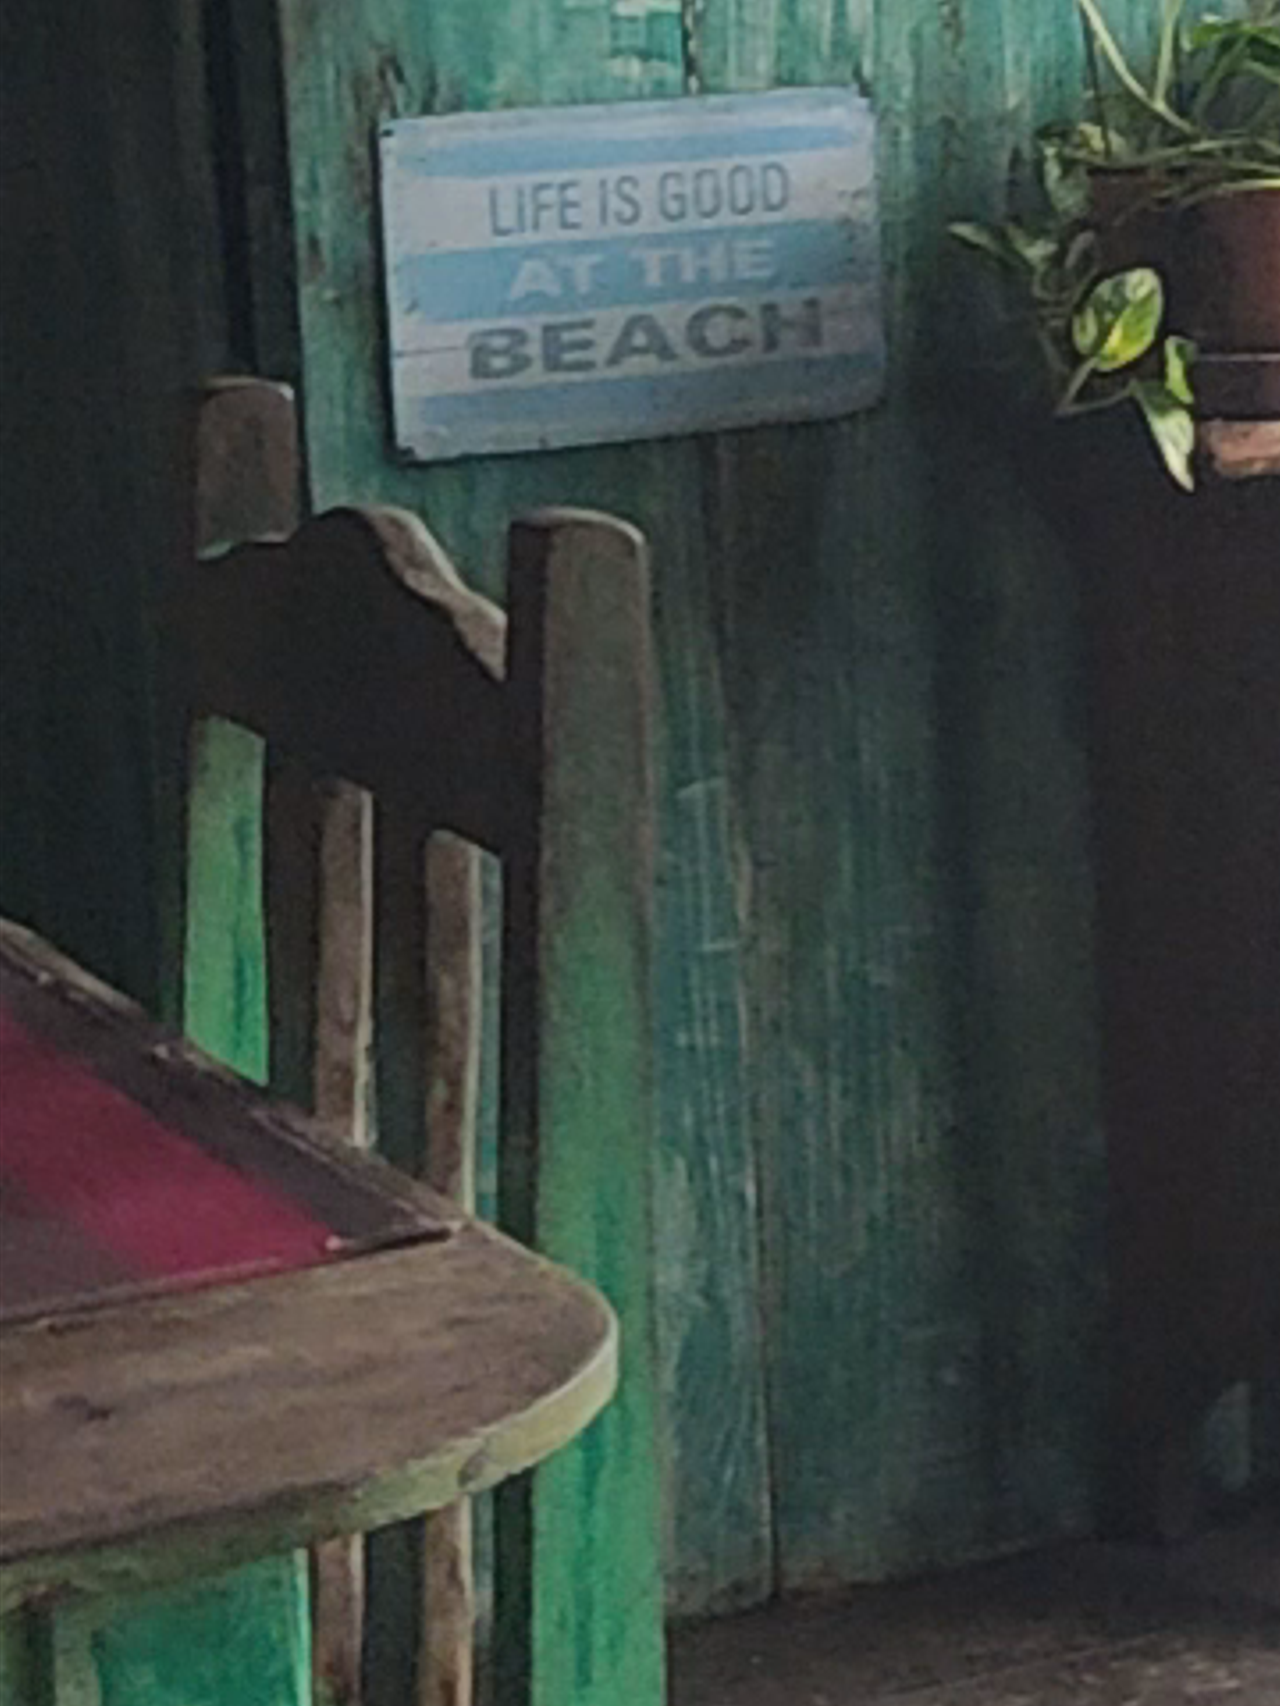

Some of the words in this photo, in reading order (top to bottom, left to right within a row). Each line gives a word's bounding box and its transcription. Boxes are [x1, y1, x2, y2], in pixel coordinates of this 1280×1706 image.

[488, 179, 582, 238] LIFE
[599, 174, 642, 228] IS
[657, 161, 791, 223] GOOD
[506, 251, 605, 302] AT
[625, 238, 776, 287] THE
[466, 297, 824, 381] BEACH
